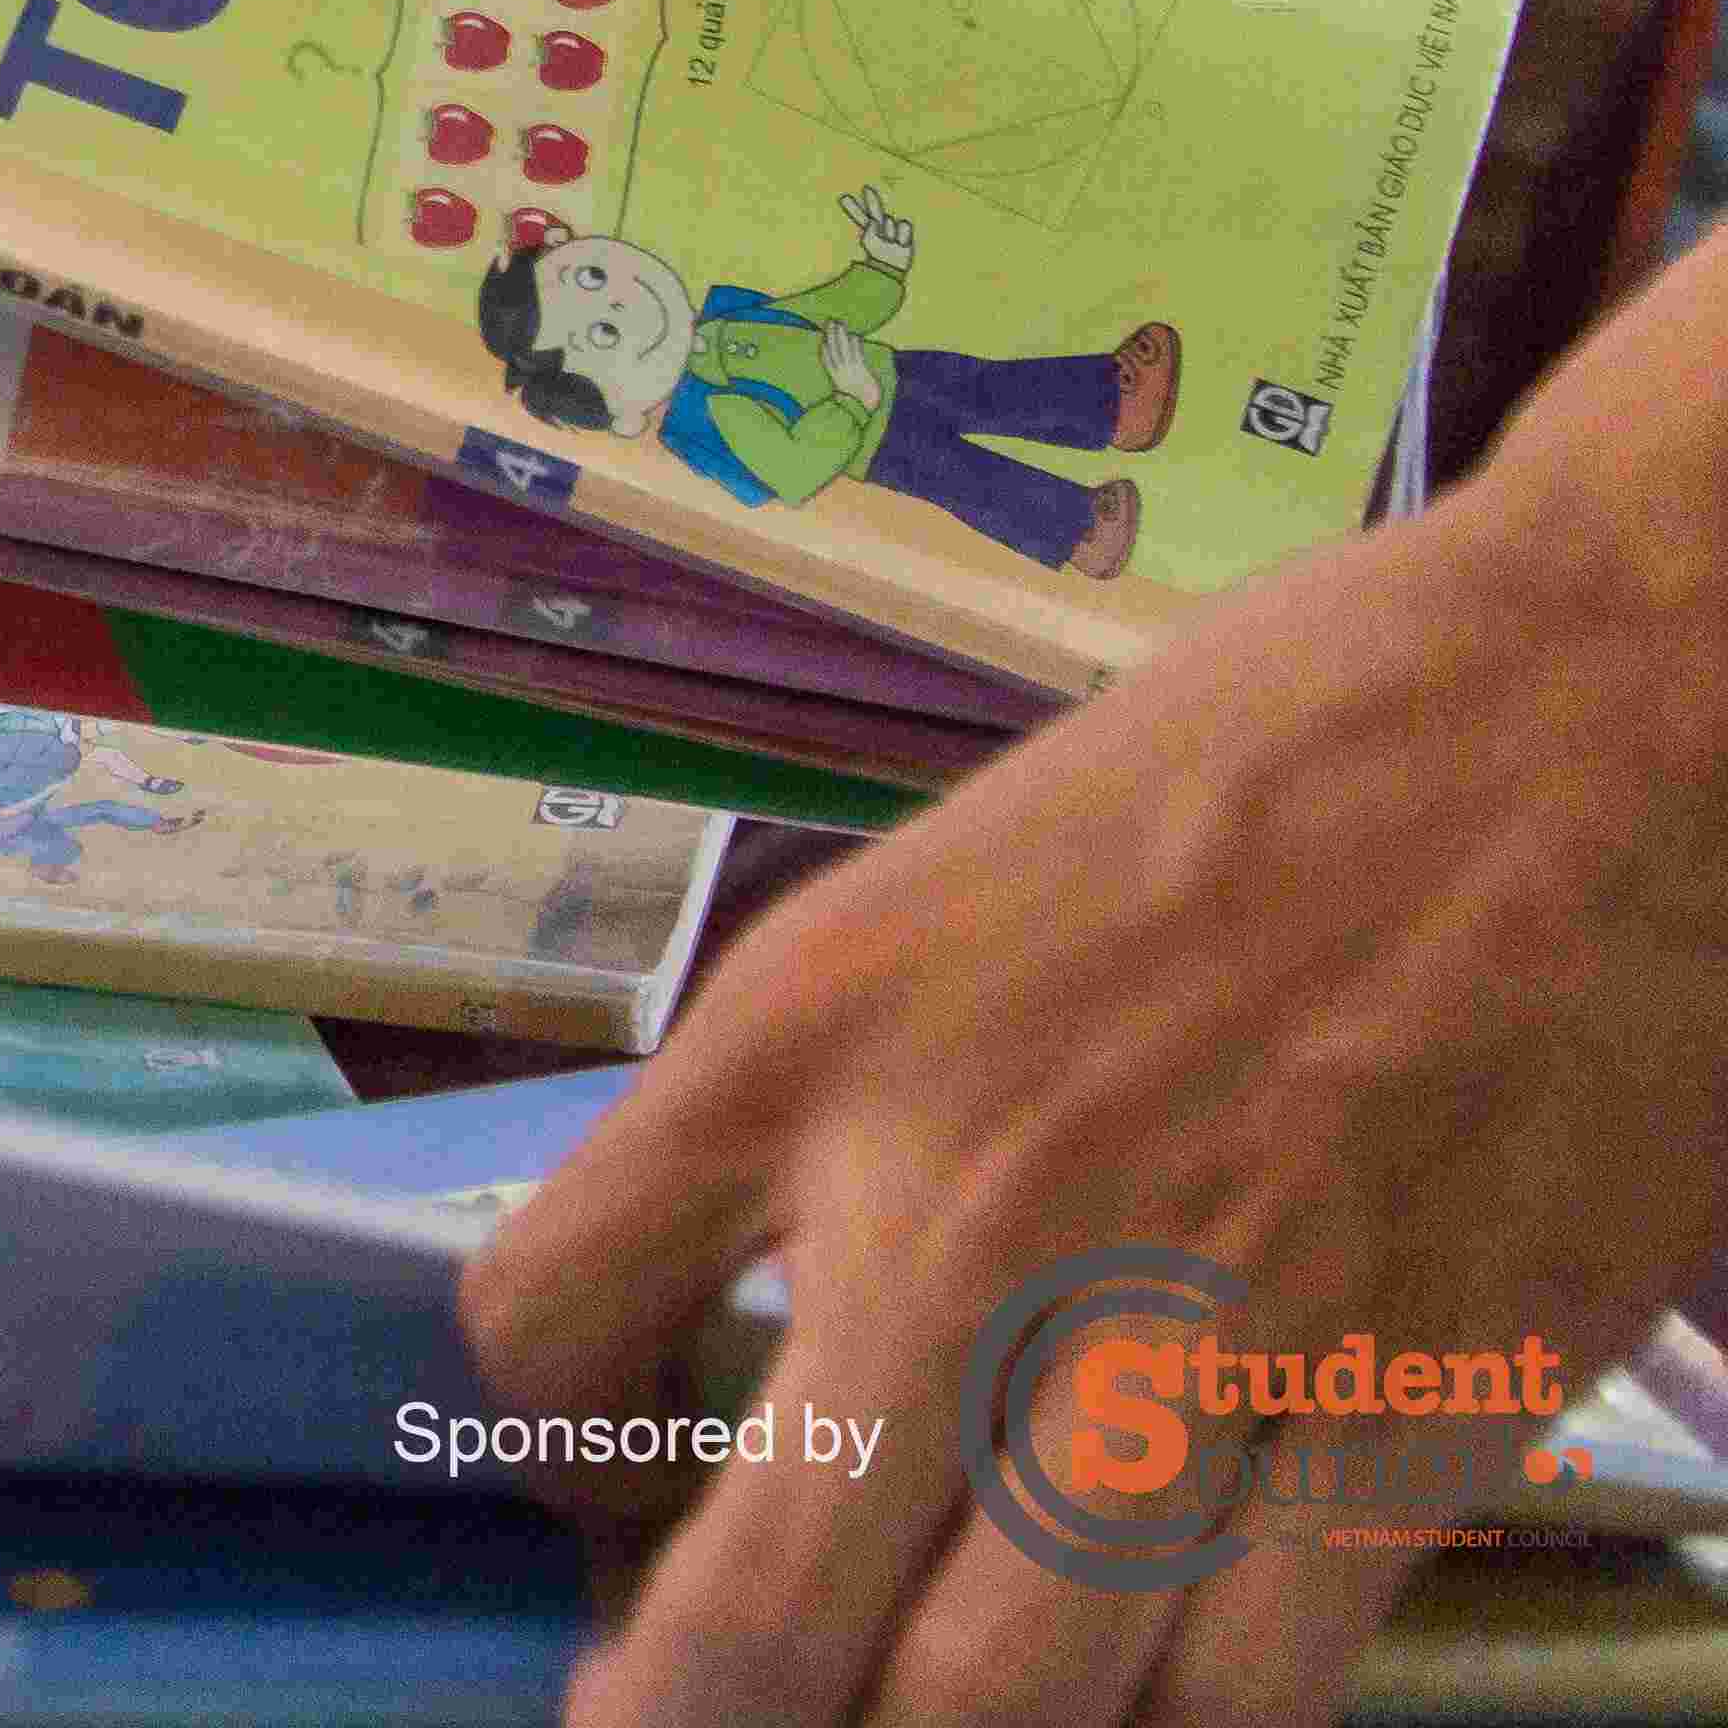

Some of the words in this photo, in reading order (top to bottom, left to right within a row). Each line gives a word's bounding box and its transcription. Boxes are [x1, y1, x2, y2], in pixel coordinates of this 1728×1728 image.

[691, 0, 730, 52] quả
[686, 48, 715, 89] 12
[1375, 134, 1419, 203] GIÁO
[1356, 201, 1399, 264] BẢN
[1335, 260, 1380, 332] XUẤT
[1315, 332, 1352, 395] NHÀ
